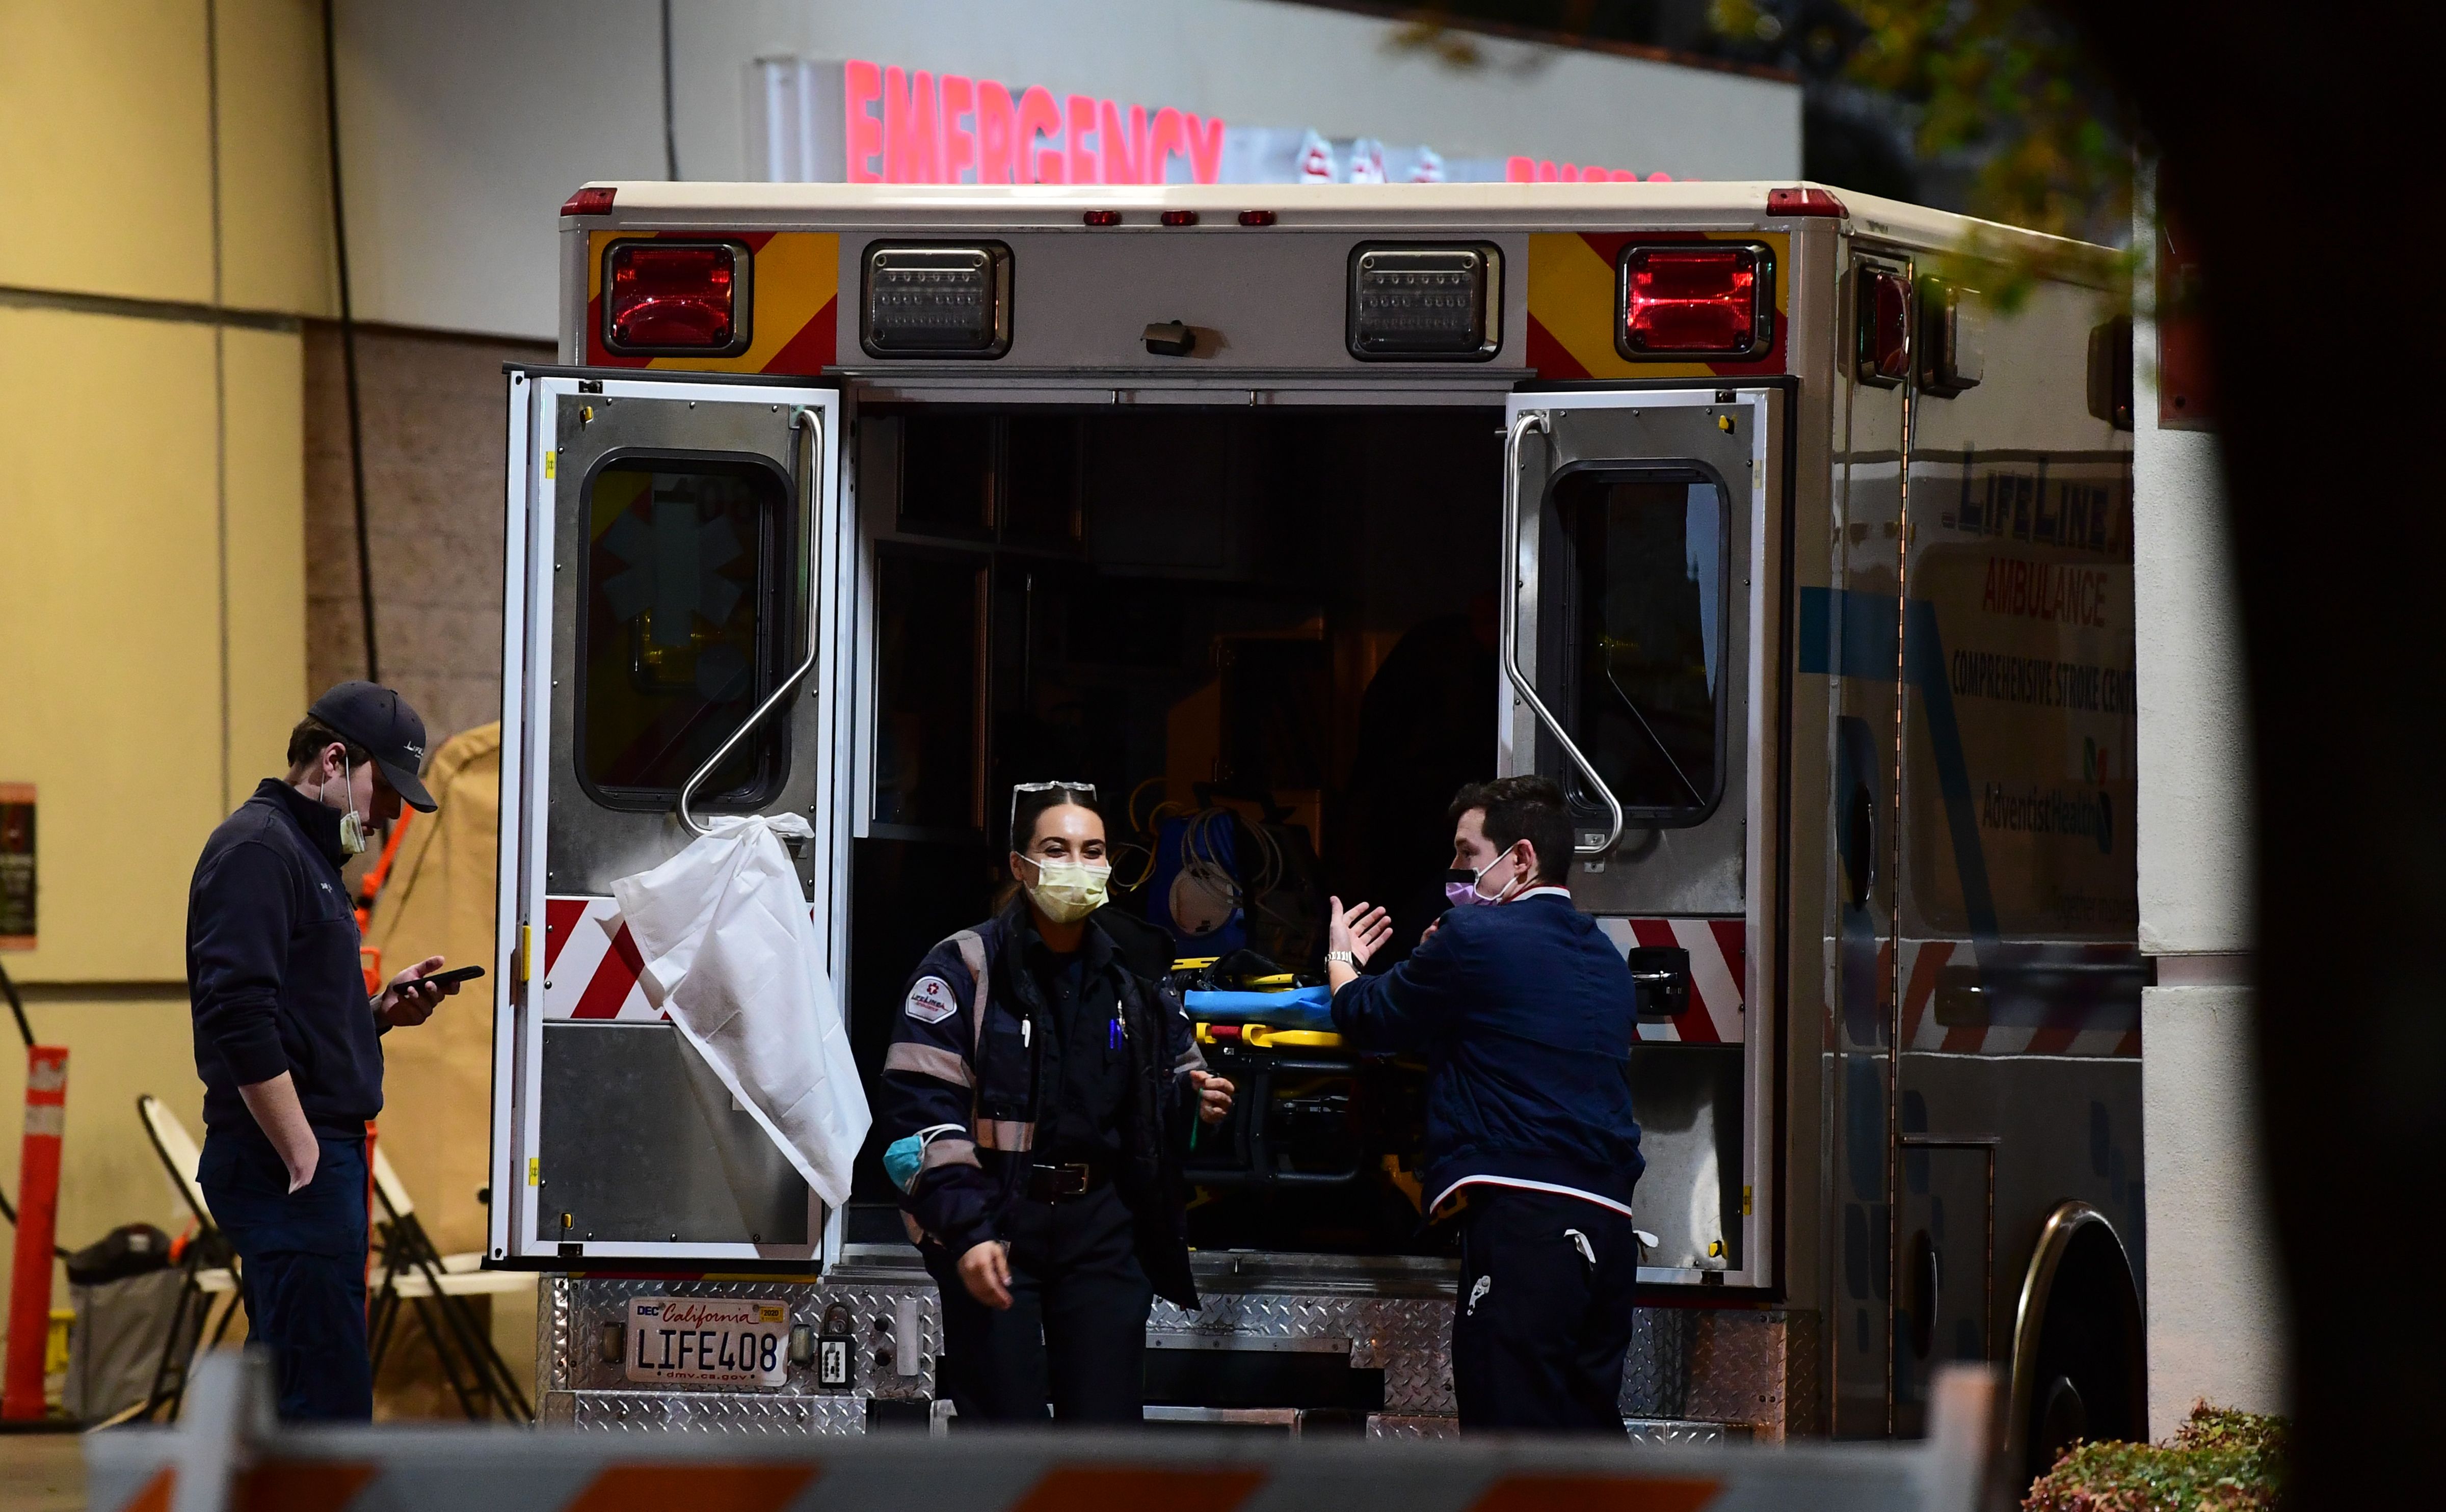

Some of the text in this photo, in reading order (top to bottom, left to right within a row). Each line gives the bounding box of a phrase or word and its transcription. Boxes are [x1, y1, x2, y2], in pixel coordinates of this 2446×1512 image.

[844, 60, 1225, 183] EMERGENCY
[1982, 556, 2108, 627] AMBULANCE
[1952, 649, 2053, 705] COMPREHENSIVE
[2056, 662, 2099, 712] STROKE
[636, 1305, 659, 1316] DEC
[662, 1303, 759, 1329] California
[638, 1329, 778, 1372] LIFE408
[666, 1371, 748, 1381] dmv.ca.gov
